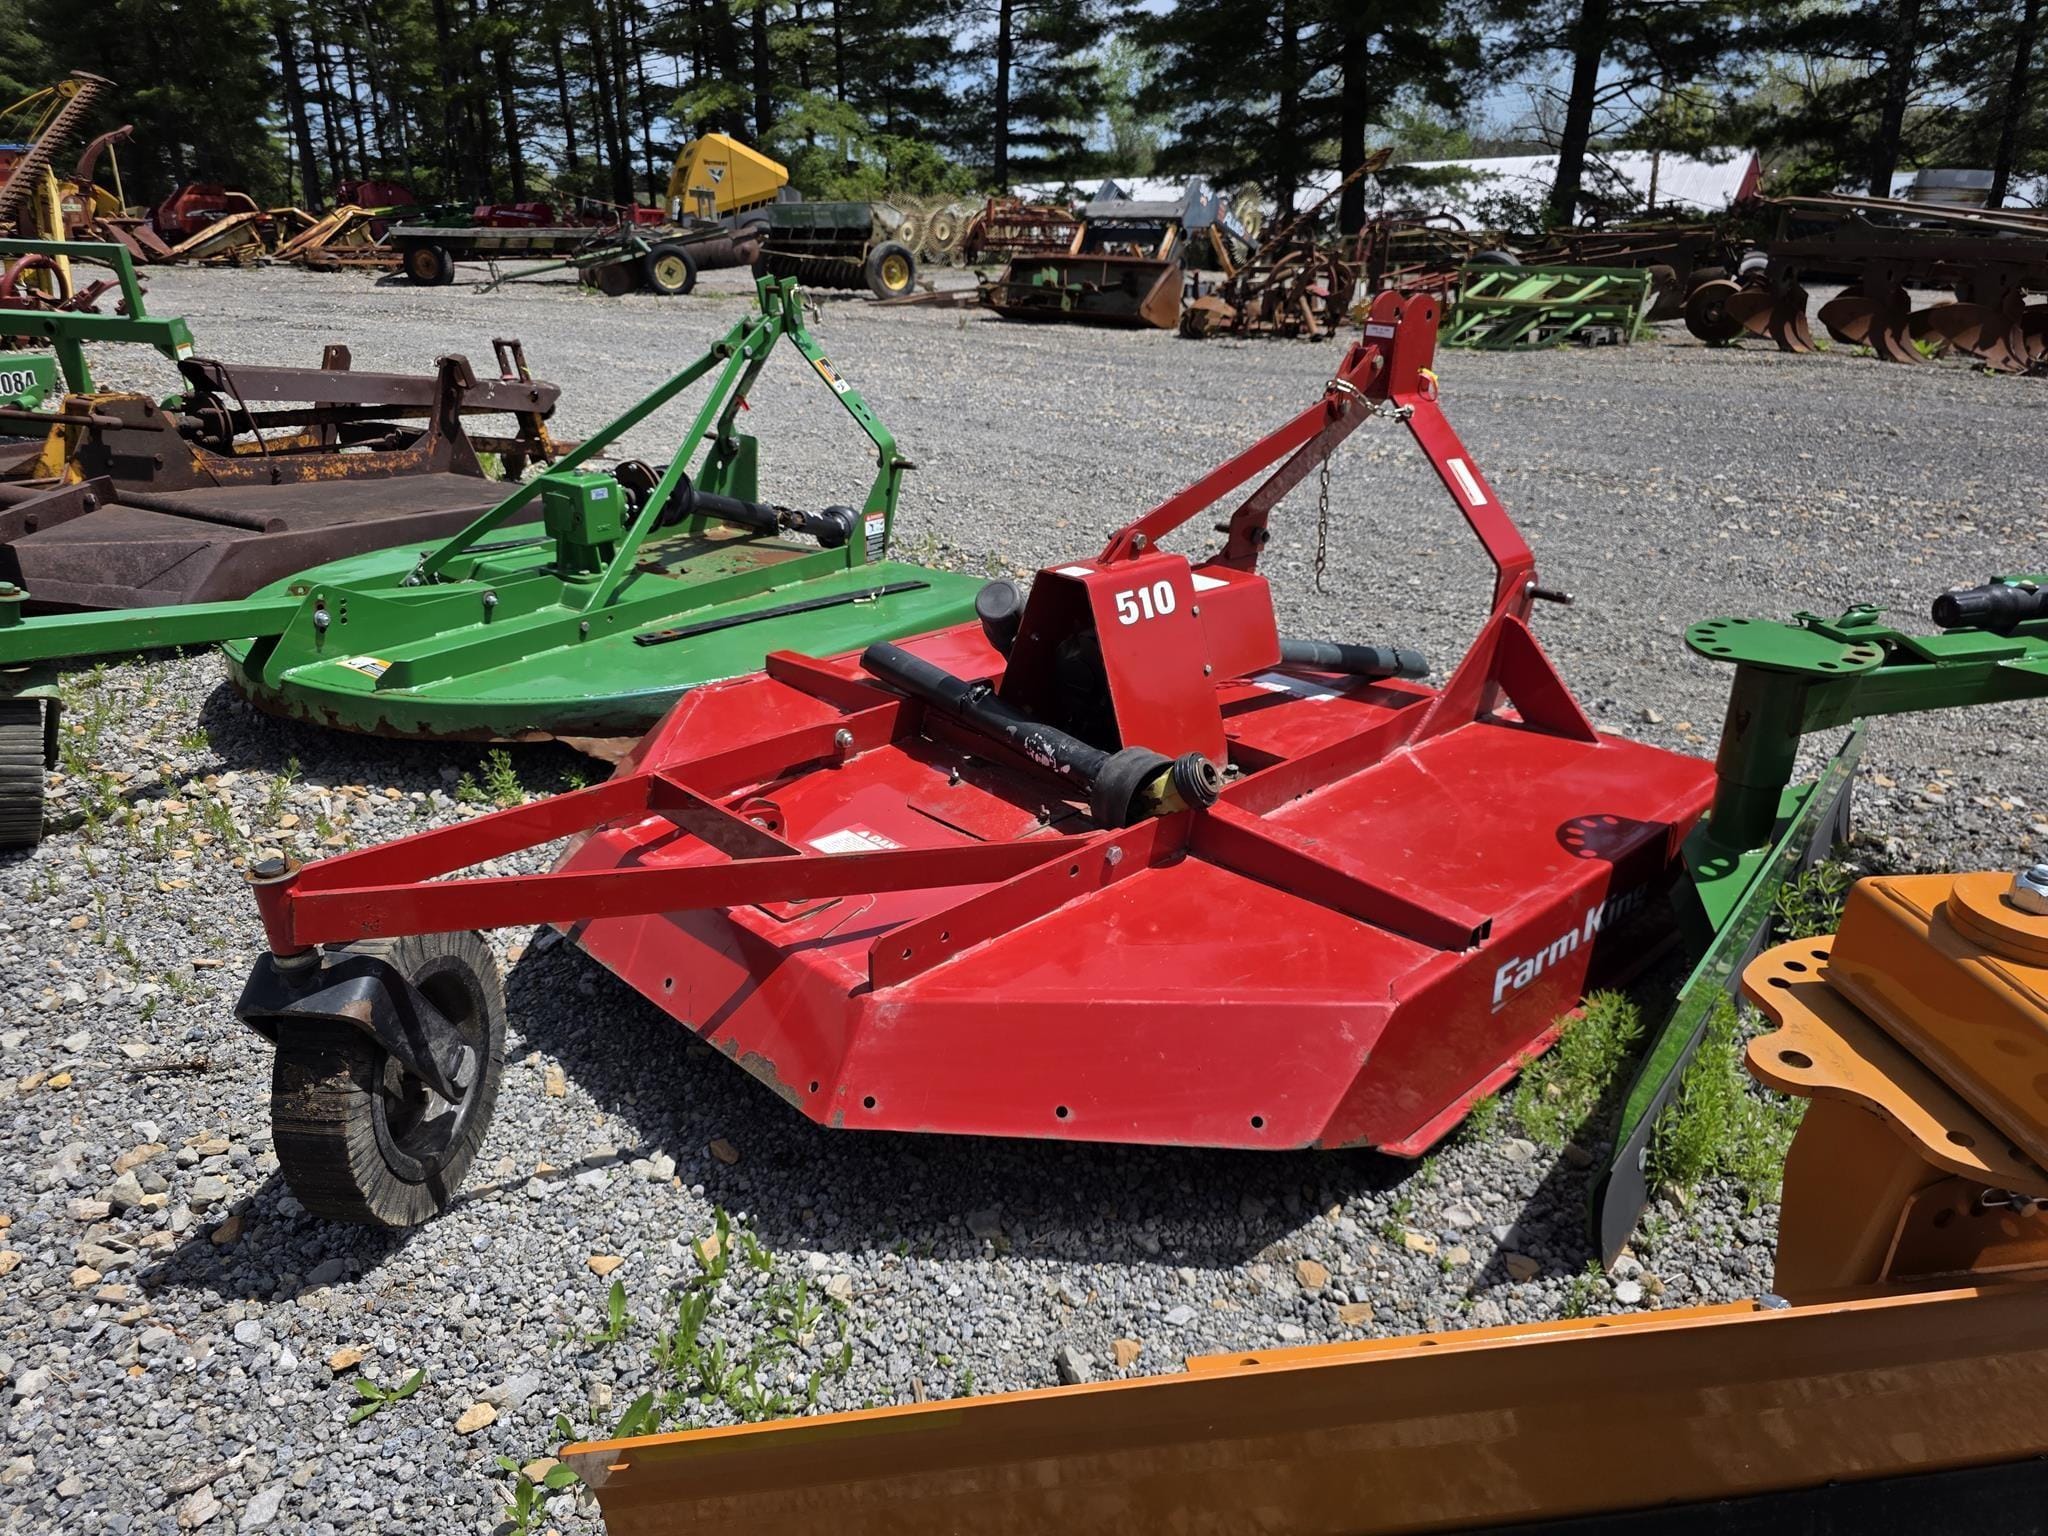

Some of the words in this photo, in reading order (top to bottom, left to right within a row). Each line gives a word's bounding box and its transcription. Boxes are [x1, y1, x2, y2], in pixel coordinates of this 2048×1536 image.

[0, 370, 36, 395] 084
[1114, 579, 1176, 625] 510
[867, 834, 901, 850] DAN
[1492, 927, 1579, 1005] Farm
[1582, 881, 1648, 943] King
